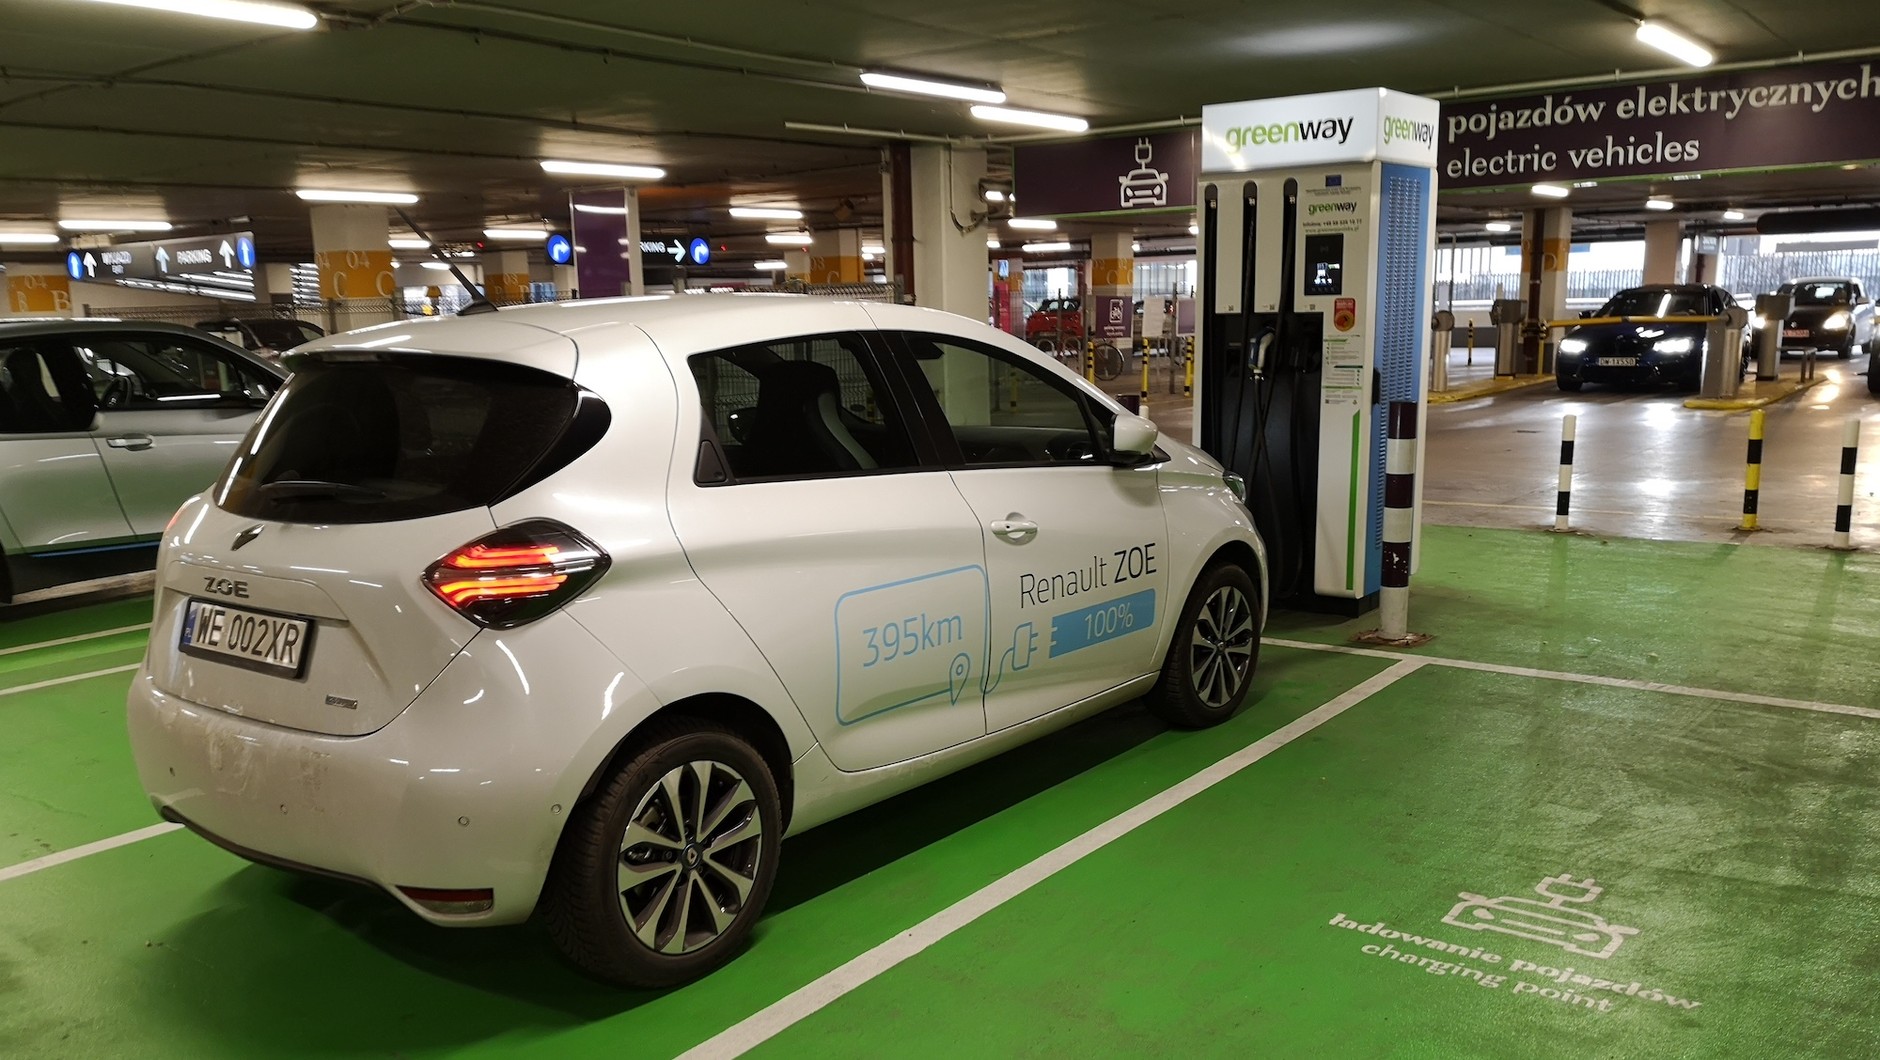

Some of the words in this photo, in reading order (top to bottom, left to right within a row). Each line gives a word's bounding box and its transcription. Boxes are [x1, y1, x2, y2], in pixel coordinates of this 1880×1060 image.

[1447, 95, 1606, 143] pojazdów
[1616, 64, 1880, 120] elektrycznych
[1225, 116, 1354, 155] greenway
[1383, 115, 1434, 149] greenway
[1447, 147, 1557, 178] electric
[1568, 131, 1700, 169] vehicles
[1308, 202, 1357, 215] greenway
[176, 248, 213, 265] PARKING
[203, 577, 249, 598] ZOE
[1020, 555, 1108, 609] Renault
[1114, 543, 1157, 583] ZOE
[197, 607, 226, 646] WE
[228, 614, 299, 663] 002XR
[863, 613, 962, 667] 395km
[1085, 602, 1134, 640] 100%
[1328, 913, 1502, 964] ładowanie
[1509, 958, 1702, 1010] pojazdów
[1361, 943, 1508, 989] charging
[1512, 980, 1617, 1013] point
